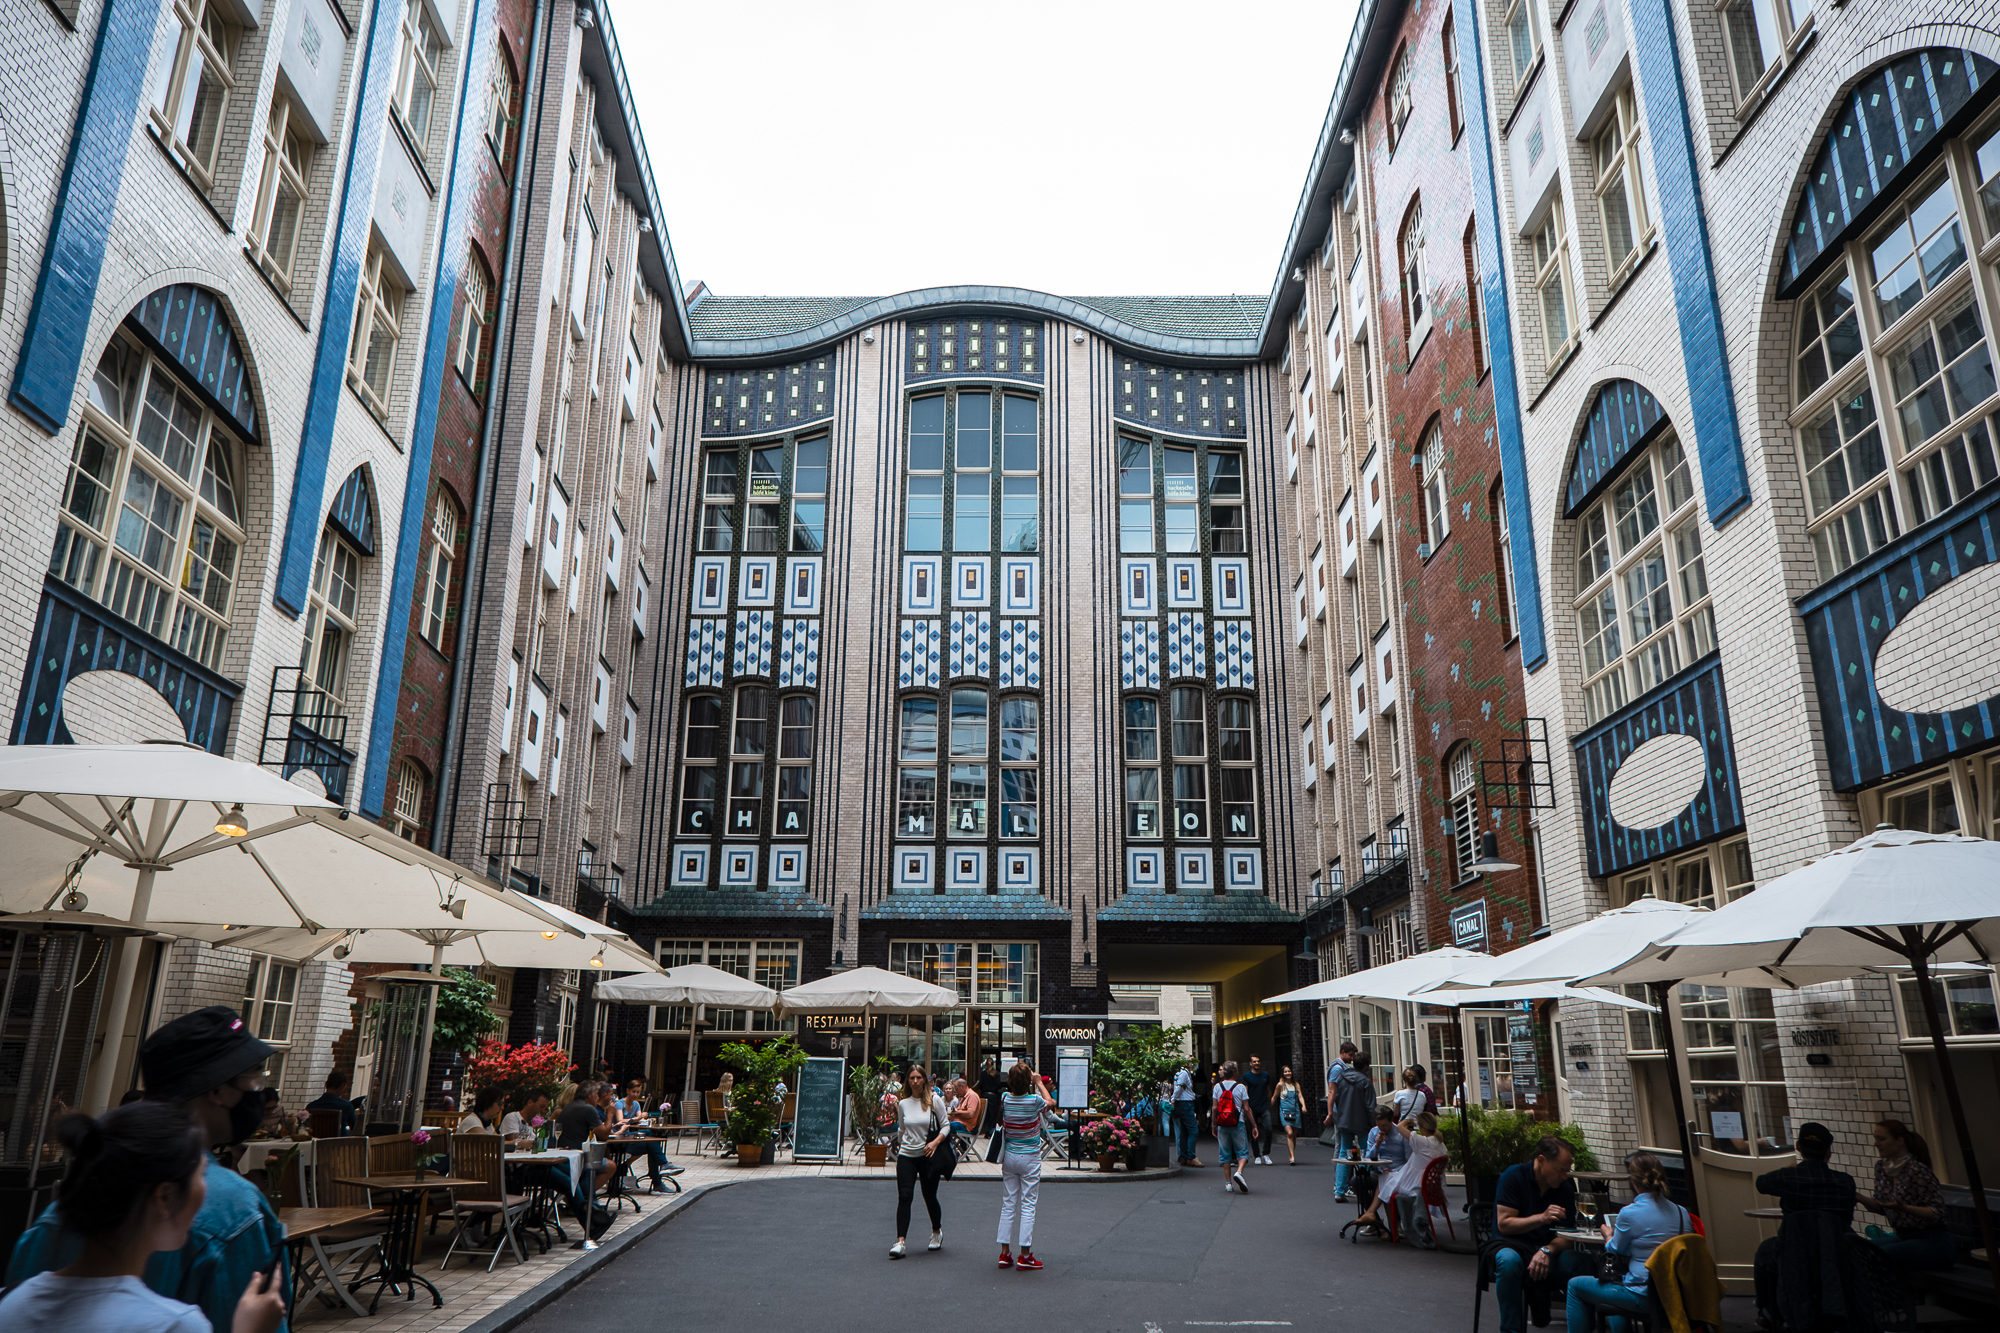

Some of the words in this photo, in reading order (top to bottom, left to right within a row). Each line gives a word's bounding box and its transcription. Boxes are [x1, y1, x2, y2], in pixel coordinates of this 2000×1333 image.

[1458, 917, 1479, 936] CANAL
[806, 1015, 878, 1028] RESTARAT
[1044, 1028, 1096, 1040] OXYMORON
